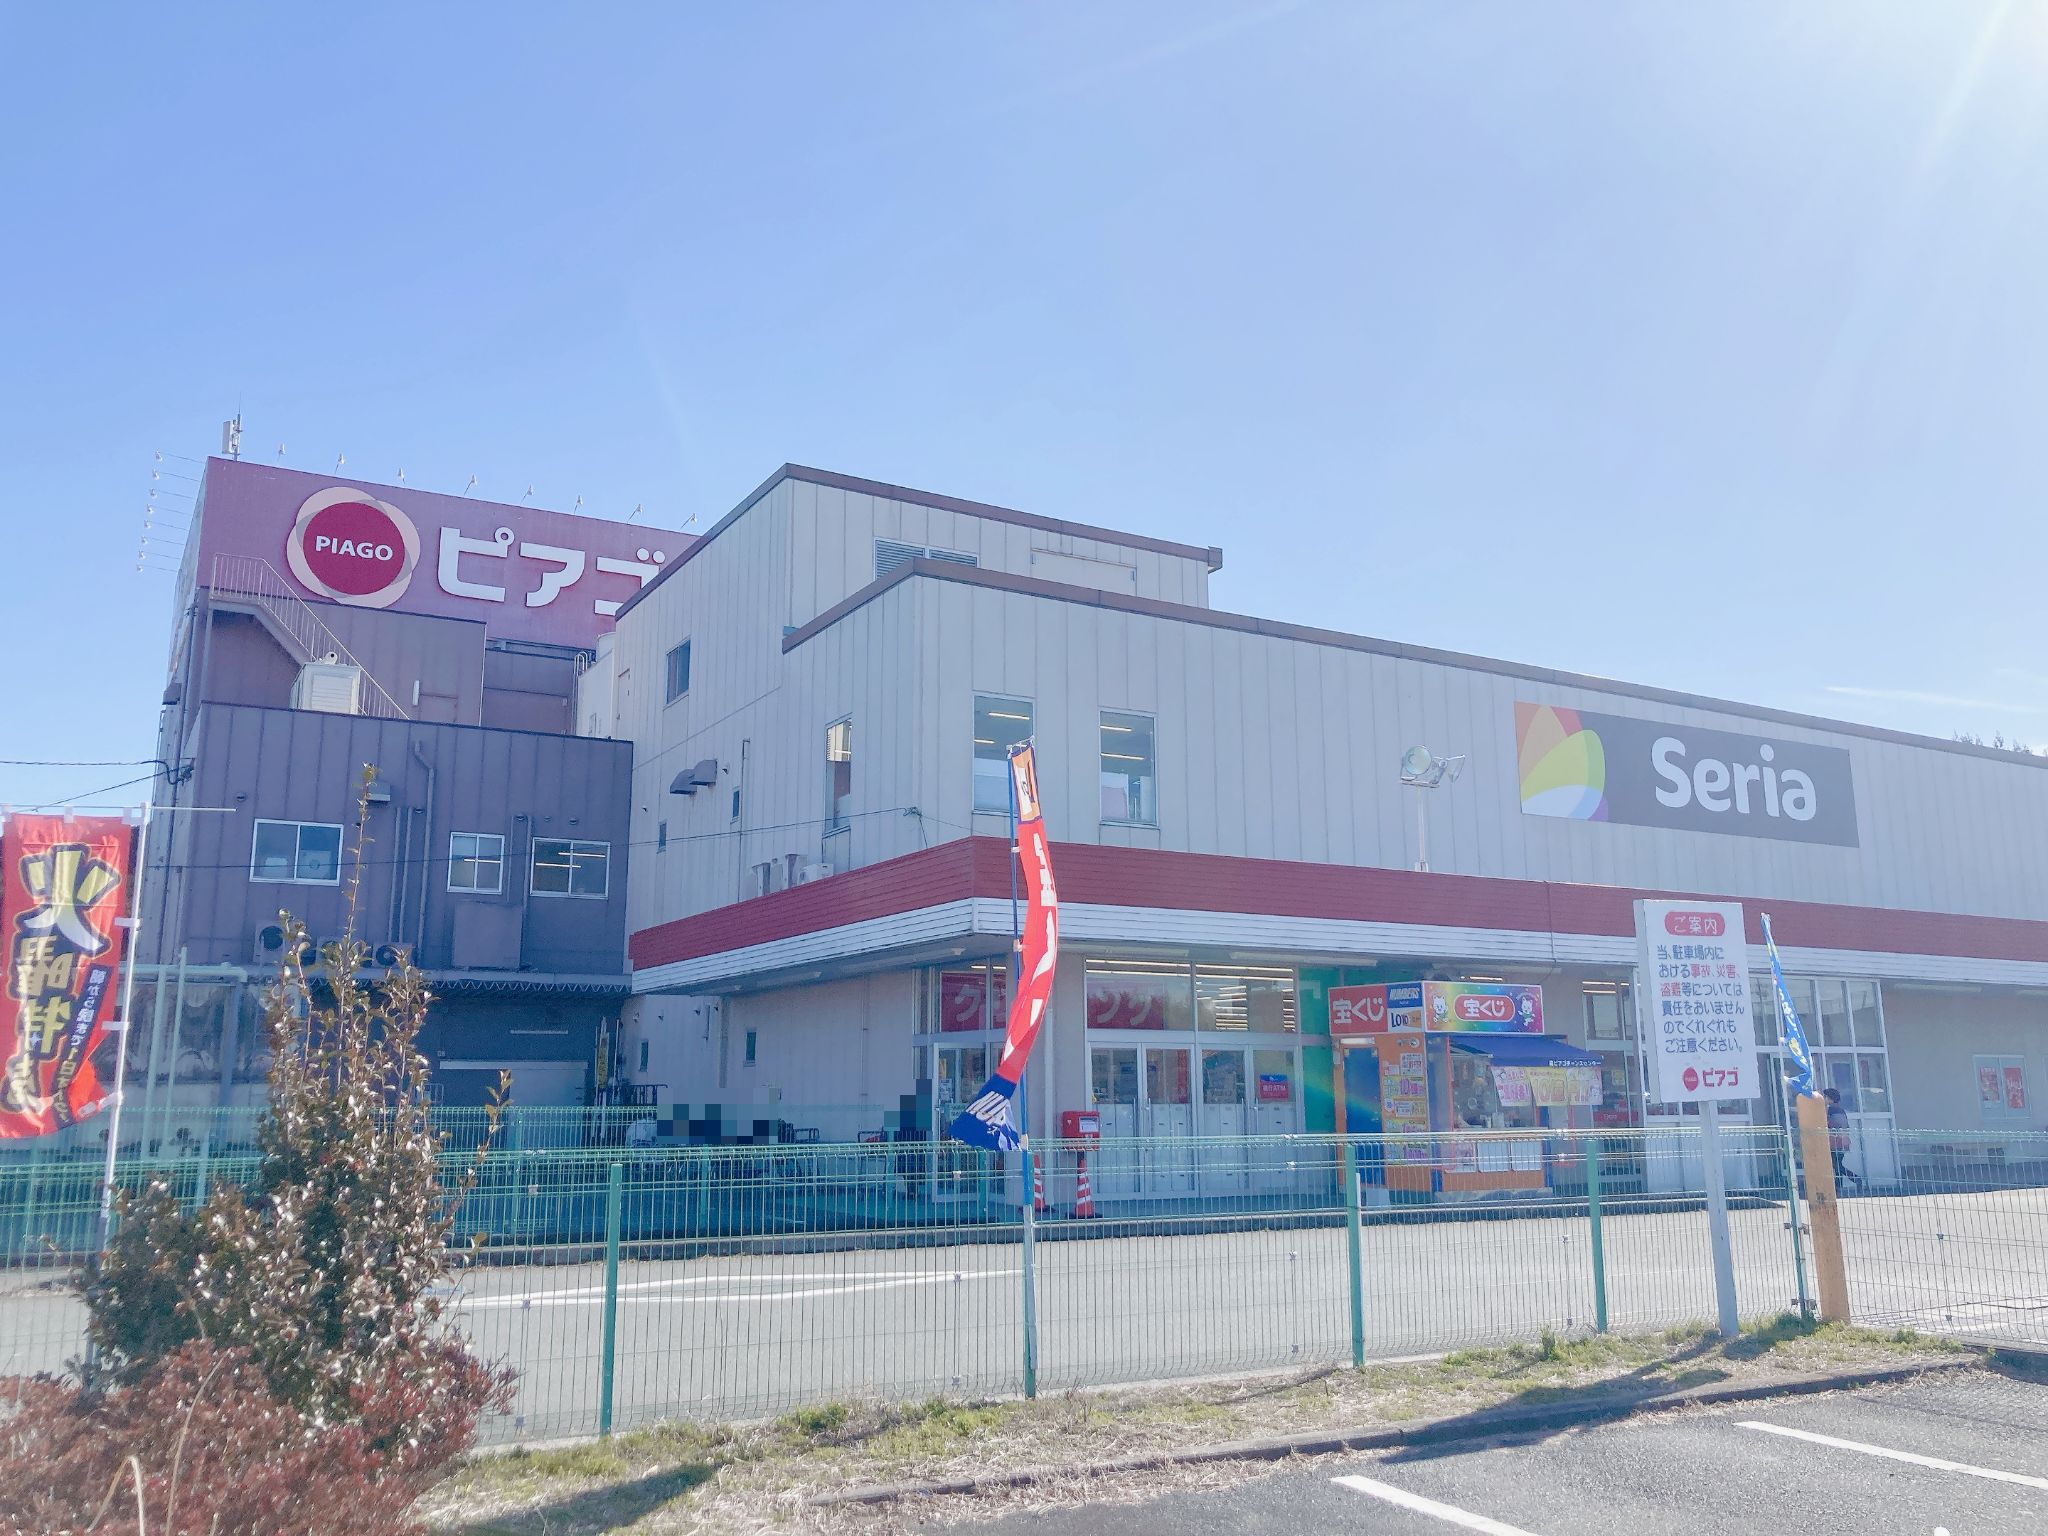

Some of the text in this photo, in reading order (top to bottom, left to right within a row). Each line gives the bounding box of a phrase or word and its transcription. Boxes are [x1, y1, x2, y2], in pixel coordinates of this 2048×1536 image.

[315, 535, 393, 561] PIAGO
[437, 526, 666, 616] ピアゴ
[1651, 736, 1817, 820] Seria
[1673, 915, 1718, 935] ご案内
[1332, 997, 1384, 1024] 宝くじ
[1464, 998, 1505, 1018] 宝くじ
[1662, 1000, 1744, 1016] 責任をおいません
[1663, 1018, 1737, 1034] のでくれぐれも
[1665, 1037, 1743, 1053] ご注意ください。
[1702, 1066, 1739, 1087] ピアゴ
